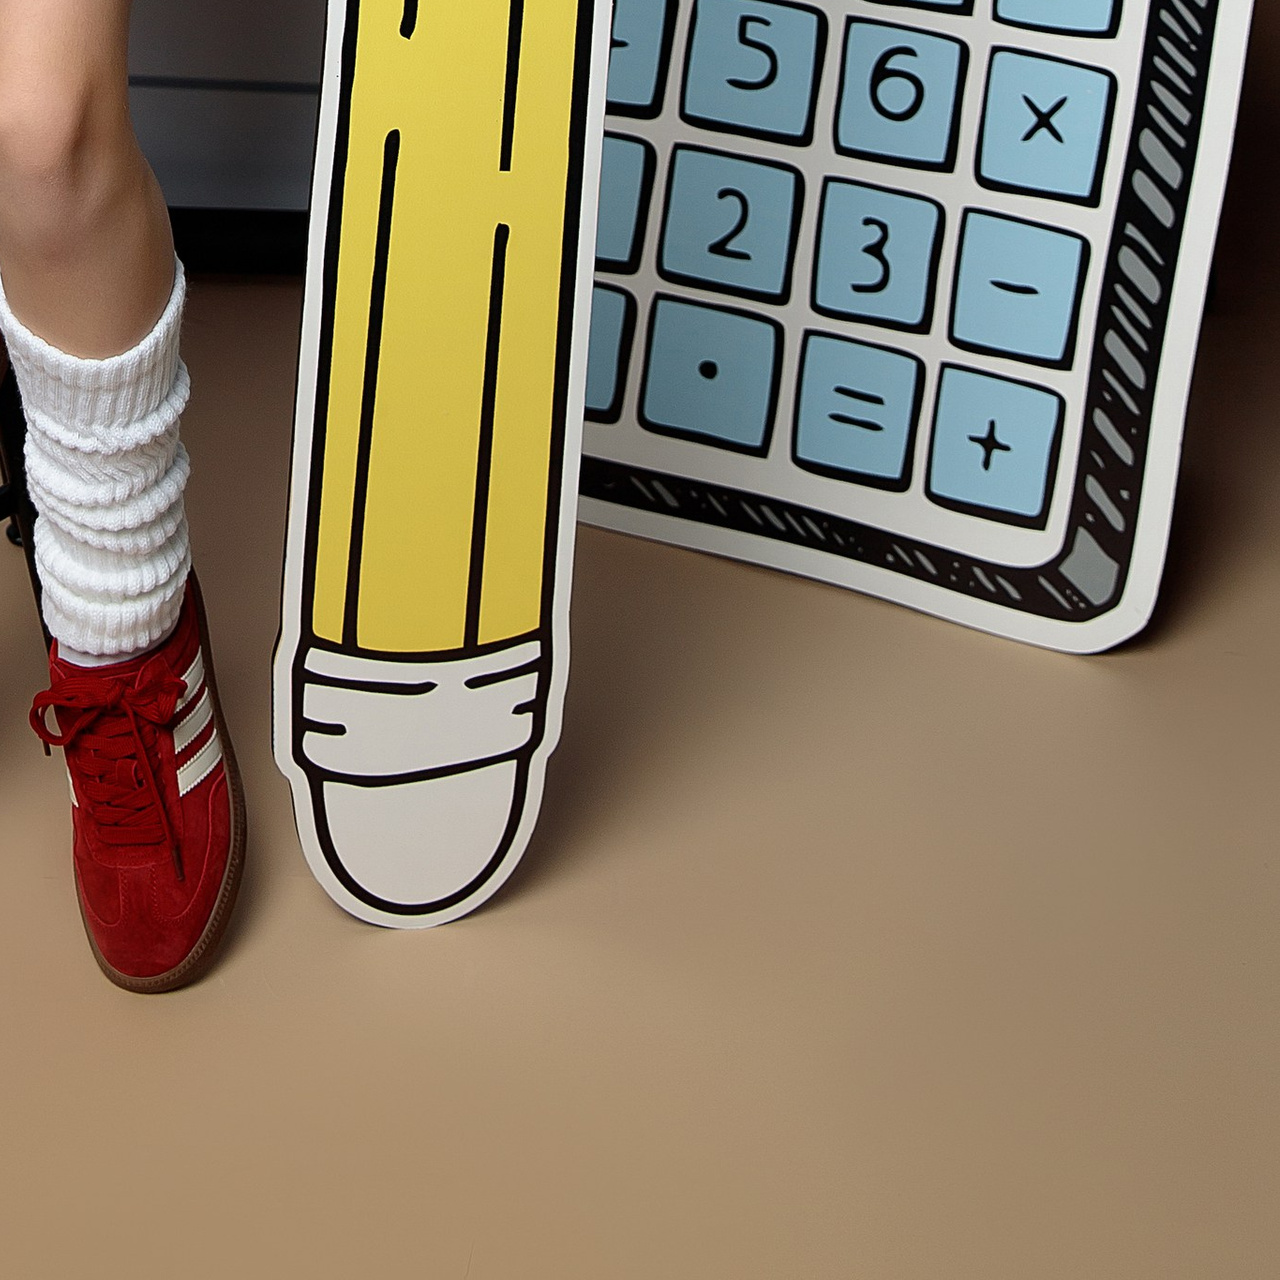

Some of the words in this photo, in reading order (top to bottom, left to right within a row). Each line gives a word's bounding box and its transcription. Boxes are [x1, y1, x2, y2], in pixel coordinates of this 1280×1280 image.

[725, 14, 779, 91] 5
[869, 46, 925, 122] 6
[707, 187, 752, 261] 2
[851, 217, 891, 294] 3
